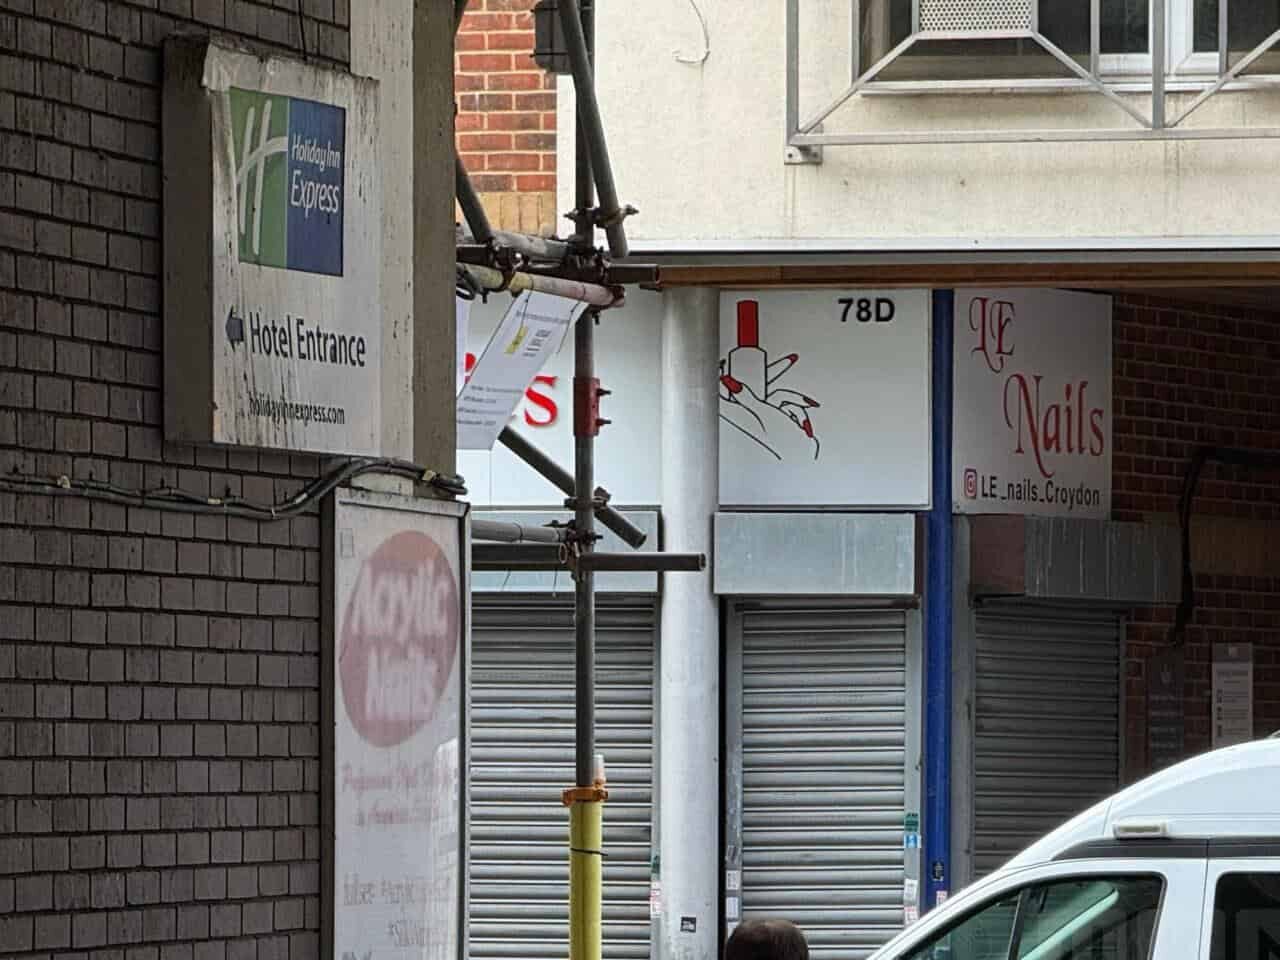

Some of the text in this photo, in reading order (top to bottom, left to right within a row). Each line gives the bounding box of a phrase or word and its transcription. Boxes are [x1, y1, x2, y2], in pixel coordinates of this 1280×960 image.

[292, 133, 327, 172] Holiday
[291, 169, 340, 218] Express
[837, 297, 896, 323] 78D
[249, 311, 367, 368] Hotel Entrance
[1004, 373, 1105, 479] Nails
